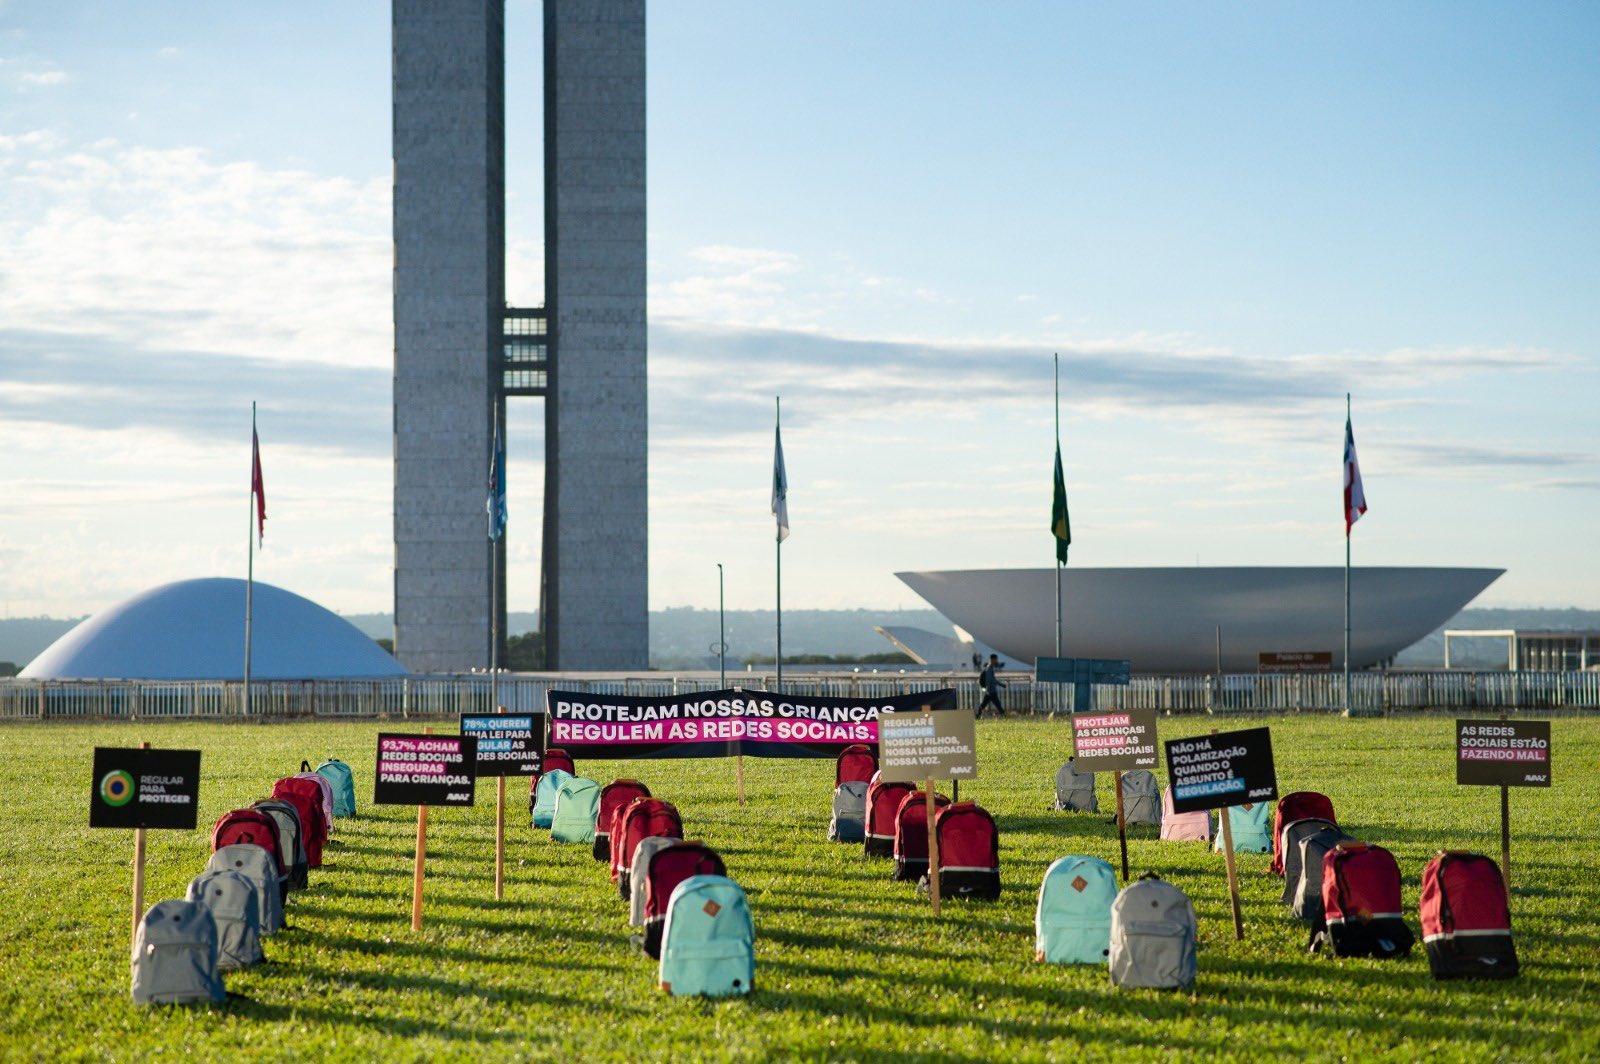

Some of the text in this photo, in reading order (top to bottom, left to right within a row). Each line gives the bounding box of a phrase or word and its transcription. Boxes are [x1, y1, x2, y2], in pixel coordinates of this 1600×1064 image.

[556, 701, 678, 721] PROTEJAM
[684, 699, 774, 718] NOSSAS
[464, 720, 530, 729] 78% QUEREM
[884, 716, 934, 727] REGULAR É
[1076, 717, 1129, 727] PROTEJAM
[505, 730, 531, 738] PARA
[556, 720, 875, 741] REGULEM AS REDES SOCIAIS.
[884, 728, 932, 736] PROTEGER
[1091, 726, 1145, 736] CRIANÇAS!
[1461, 727, 1515, 736] AS REDES
[382, 740, 459, 752] 93,7% ACHAM
[477, 741, 525, 749] GULAR AS
[885, 737, 960, 747] NOSSOS FILHOS,
[1078, 738, 1123, 748] REGULEM
[1171, 739, 1211, 754] NÃO HÁ
[1461, 738, 1546, 748] SOCIAIS ESTÃO
[477, 751, 539, 760] DES SOCIAIS.
[885, 746, 971, 756] NOSSA LIBERDADE,
[1078, 746, 1154, 757] REDES SOCIAIS!
[1173, 747, 1247, 765] POLARIZAÇÃO
[1461, 750, 1545, 760] FAZENDO MAL.
[382, 752, 463, 762] REDES SOCIAIS
[886, 758, 917, 766] NOSSA
[381, 763, 444, 772] INSEGURAS
[1174, 761, 1230, 776] QUANDO O
[141, 776, 184, 785] REGULAR
[381, 774, 470, 786] PARA CRIANÇAS.
[1176, 769, 1234, 786] ASSUNTO É
[140, 785, 166, 793] PARA
[1177, 780, 1244, 797] REGULAÇÃO.
[139, 795, 190, 803] PROTEGER
